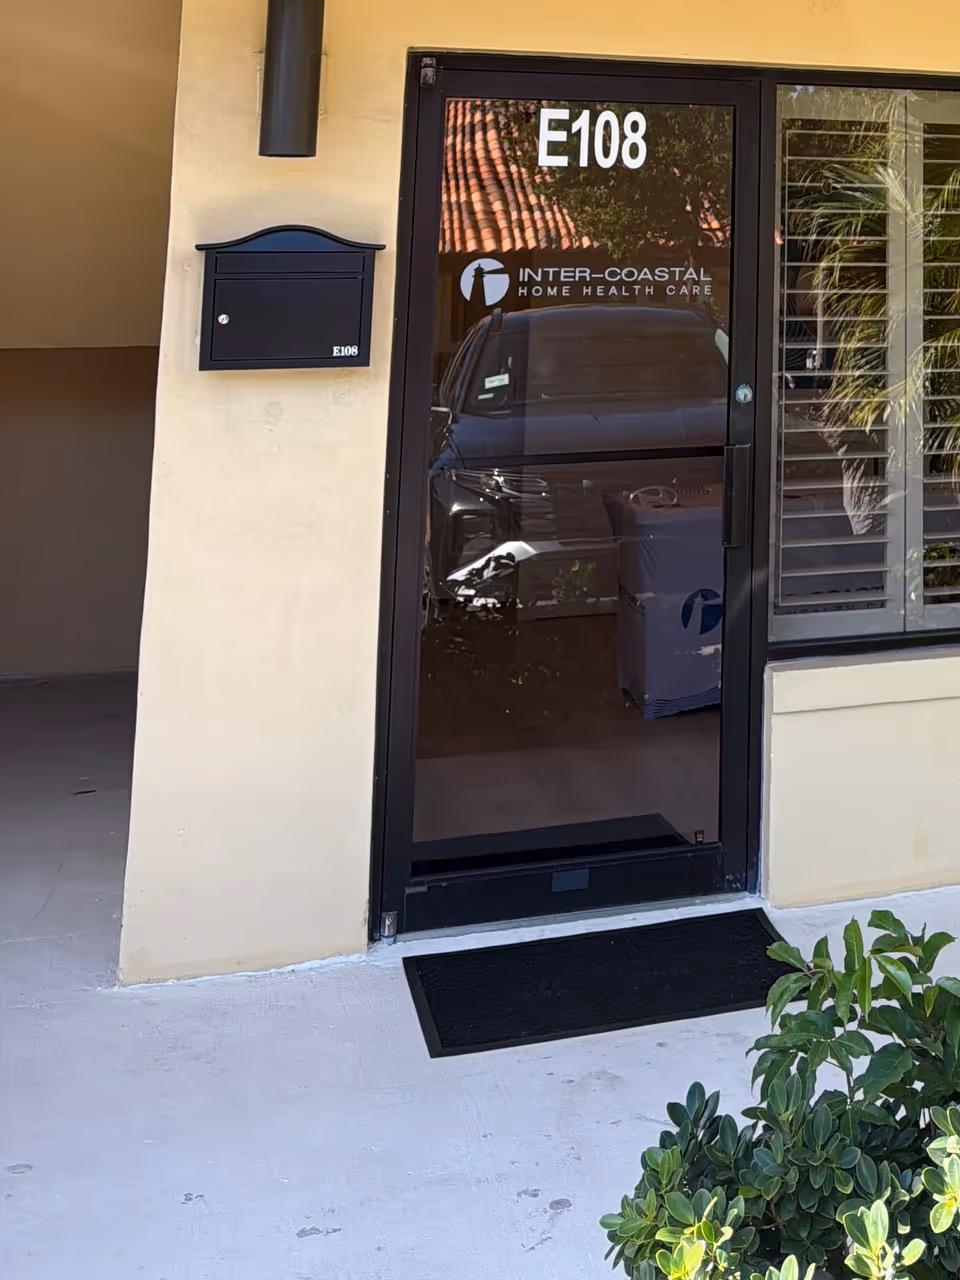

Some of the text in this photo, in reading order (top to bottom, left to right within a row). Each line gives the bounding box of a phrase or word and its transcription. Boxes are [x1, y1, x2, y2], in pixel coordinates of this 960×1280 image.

[538, 108, 647, 170] E108
[518, 266, 713, 282] INTER-COASTAL
[518, 284, 713, 297] HOME HEALTH CARE
[332, 345, 359, 357] E108
